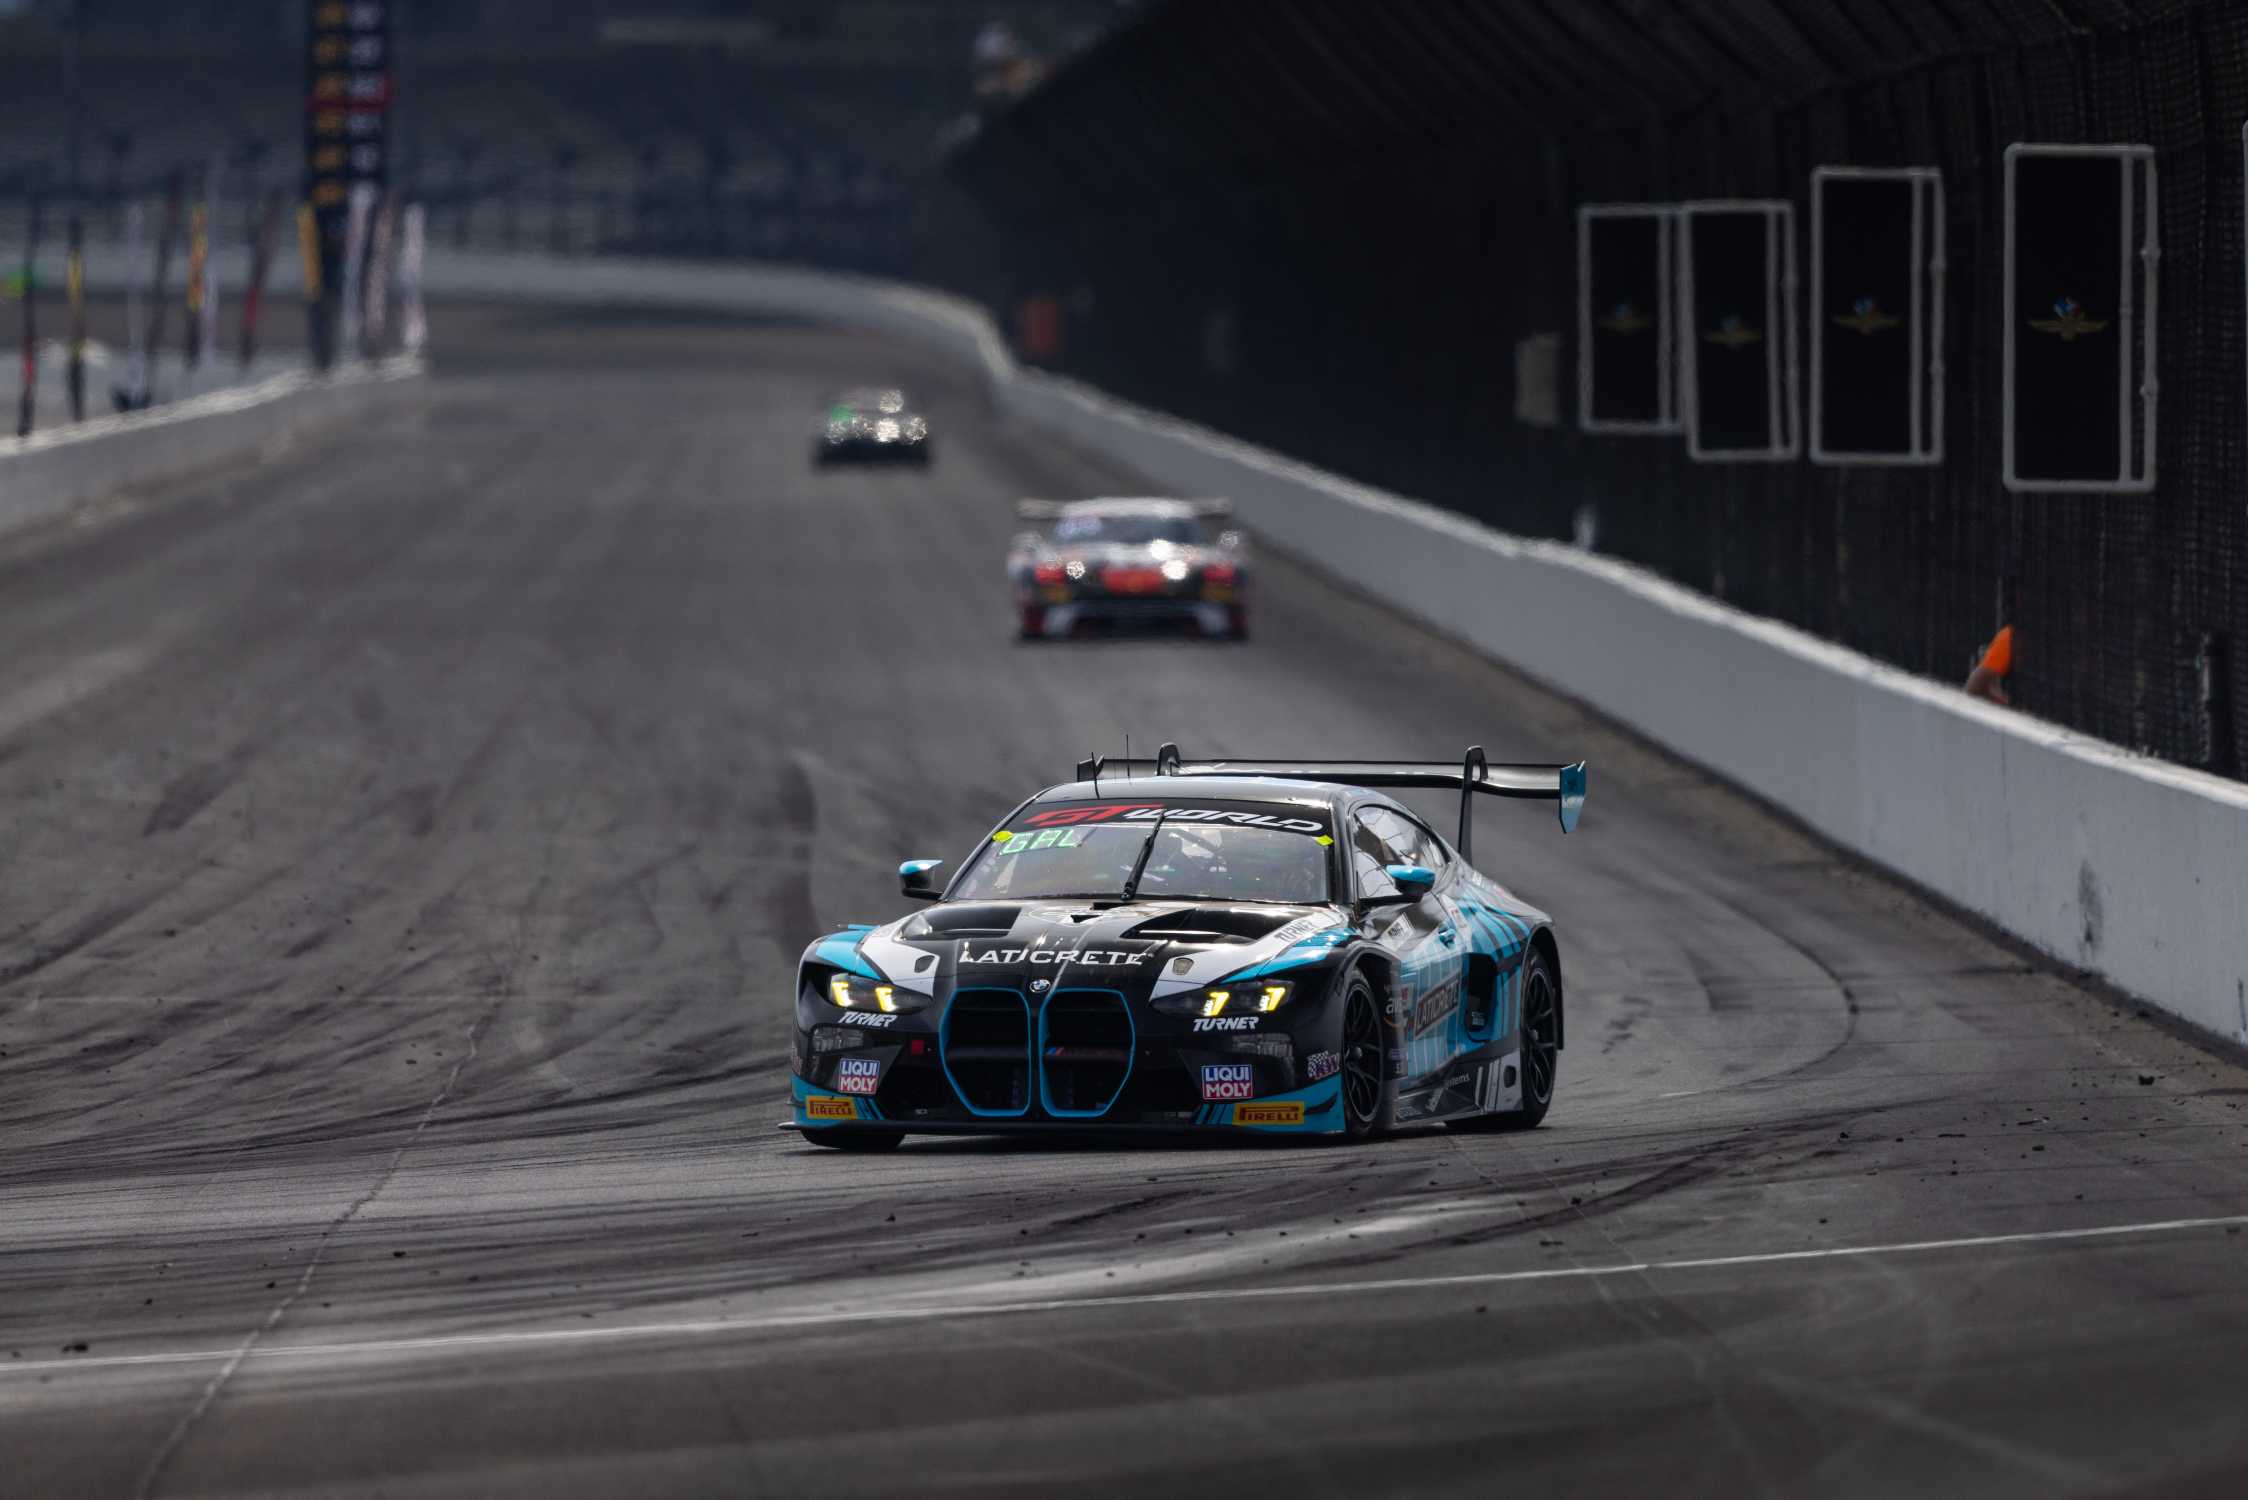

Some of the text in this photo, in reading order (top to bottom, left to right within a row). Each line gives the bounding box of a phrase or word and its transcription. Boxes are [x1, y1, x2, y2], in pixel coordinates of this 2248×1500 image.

[958, 948, 1147, 966] LATICRETE
[838, 1011, 898, 1028] TURNER
[1192, 1016, 1260, 1032] TURNER
[841, 1061, 878, 1076] LIQUI
[1204, 1066, 1250, 1081] LIQUI
[840, 1076, 877, 1092] MOLY
[1205, 1081, 1251, 1098] MOLY
[1238, 1106, 1300, 1122] PIRELLI
